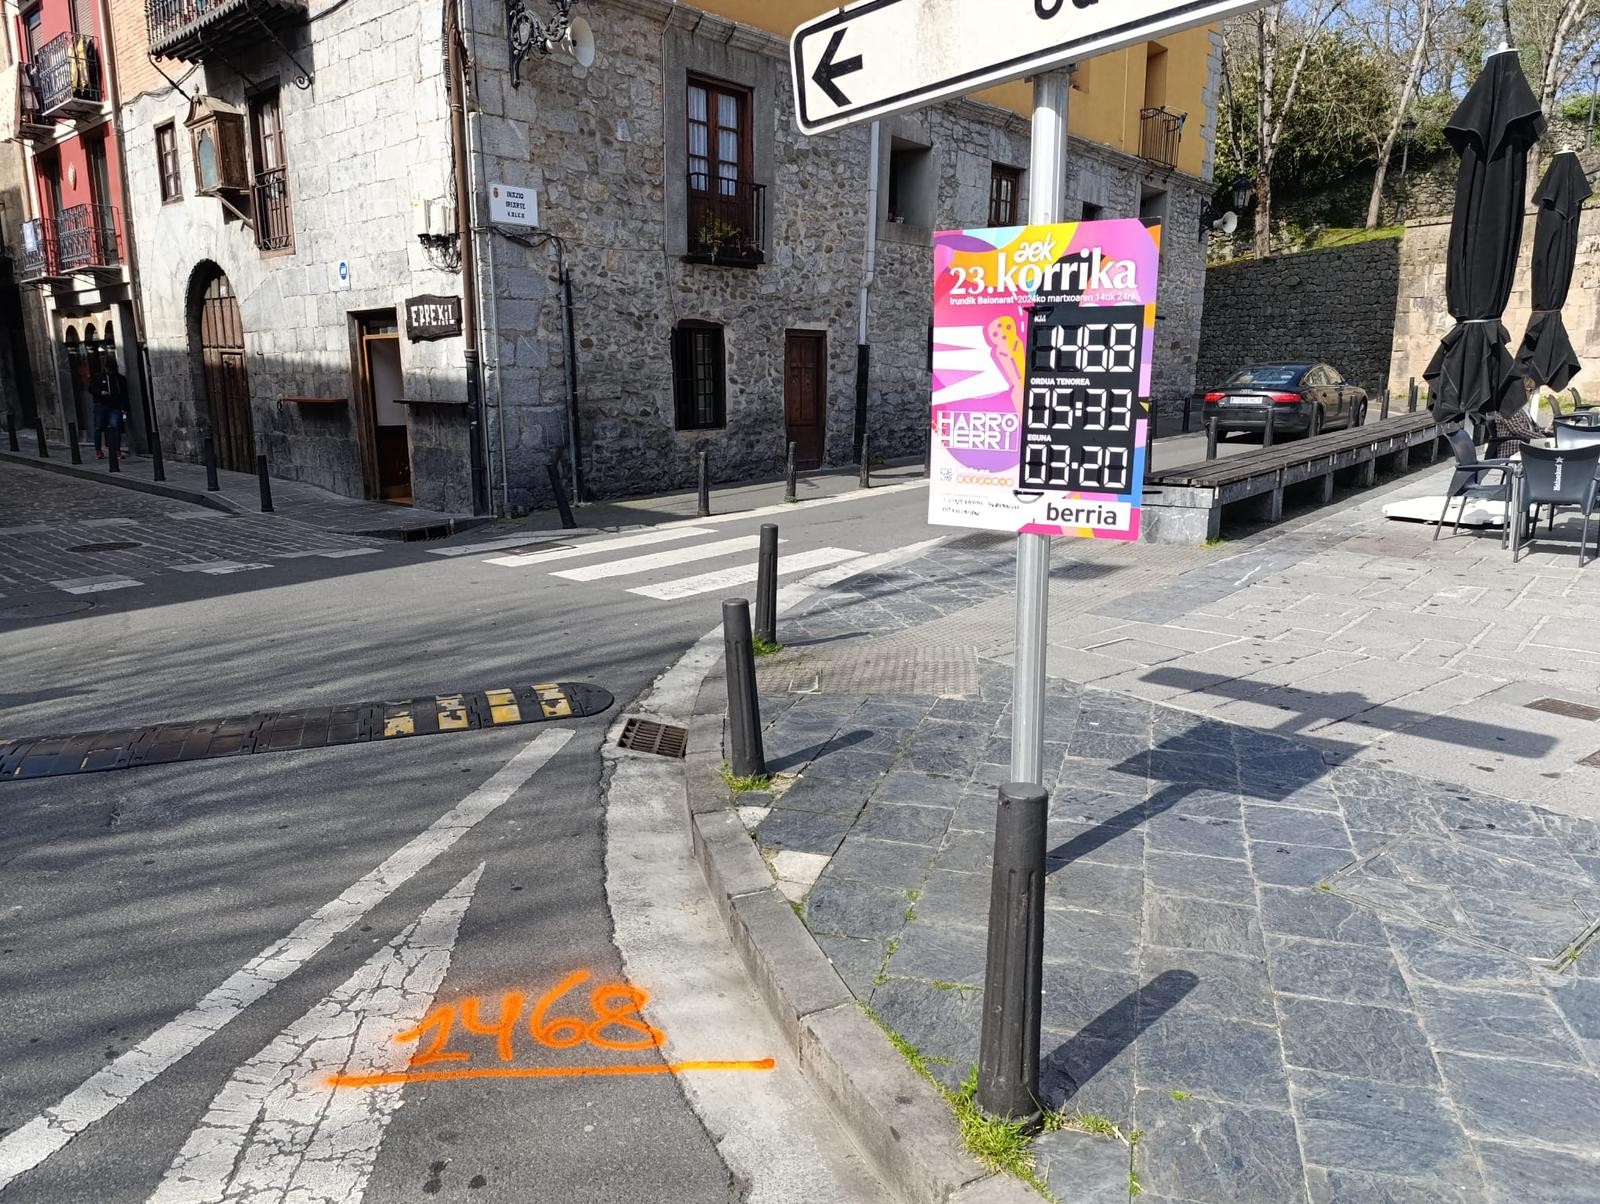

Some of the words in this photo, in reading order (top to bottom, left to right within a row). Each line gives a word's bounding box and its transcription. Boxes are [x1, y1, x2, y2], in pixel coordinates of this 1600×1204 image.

[1013, 233, 1055, 263] aek
[950, 296, 976, 305] Irundik
[977, 295, 1014, 304] Baionarat
[1017, 294, 1046, 303] 2024ko
[1047, 293, 1093, 302] martxoaren
[1050, 323, 1137, 373] 1468
[1030, 377, 1055, 386] ORDUA
[1056, 378, 1090, 387] TENOREA
[1027, 387, 1132, 431] 05:33
[937, 411, 1018, 432] HARRO
[938, 430, 1010, 450] HERRI
[1027, 433, 1051, 442] EGUNA
[1046, 502, 1118, 526] berria
